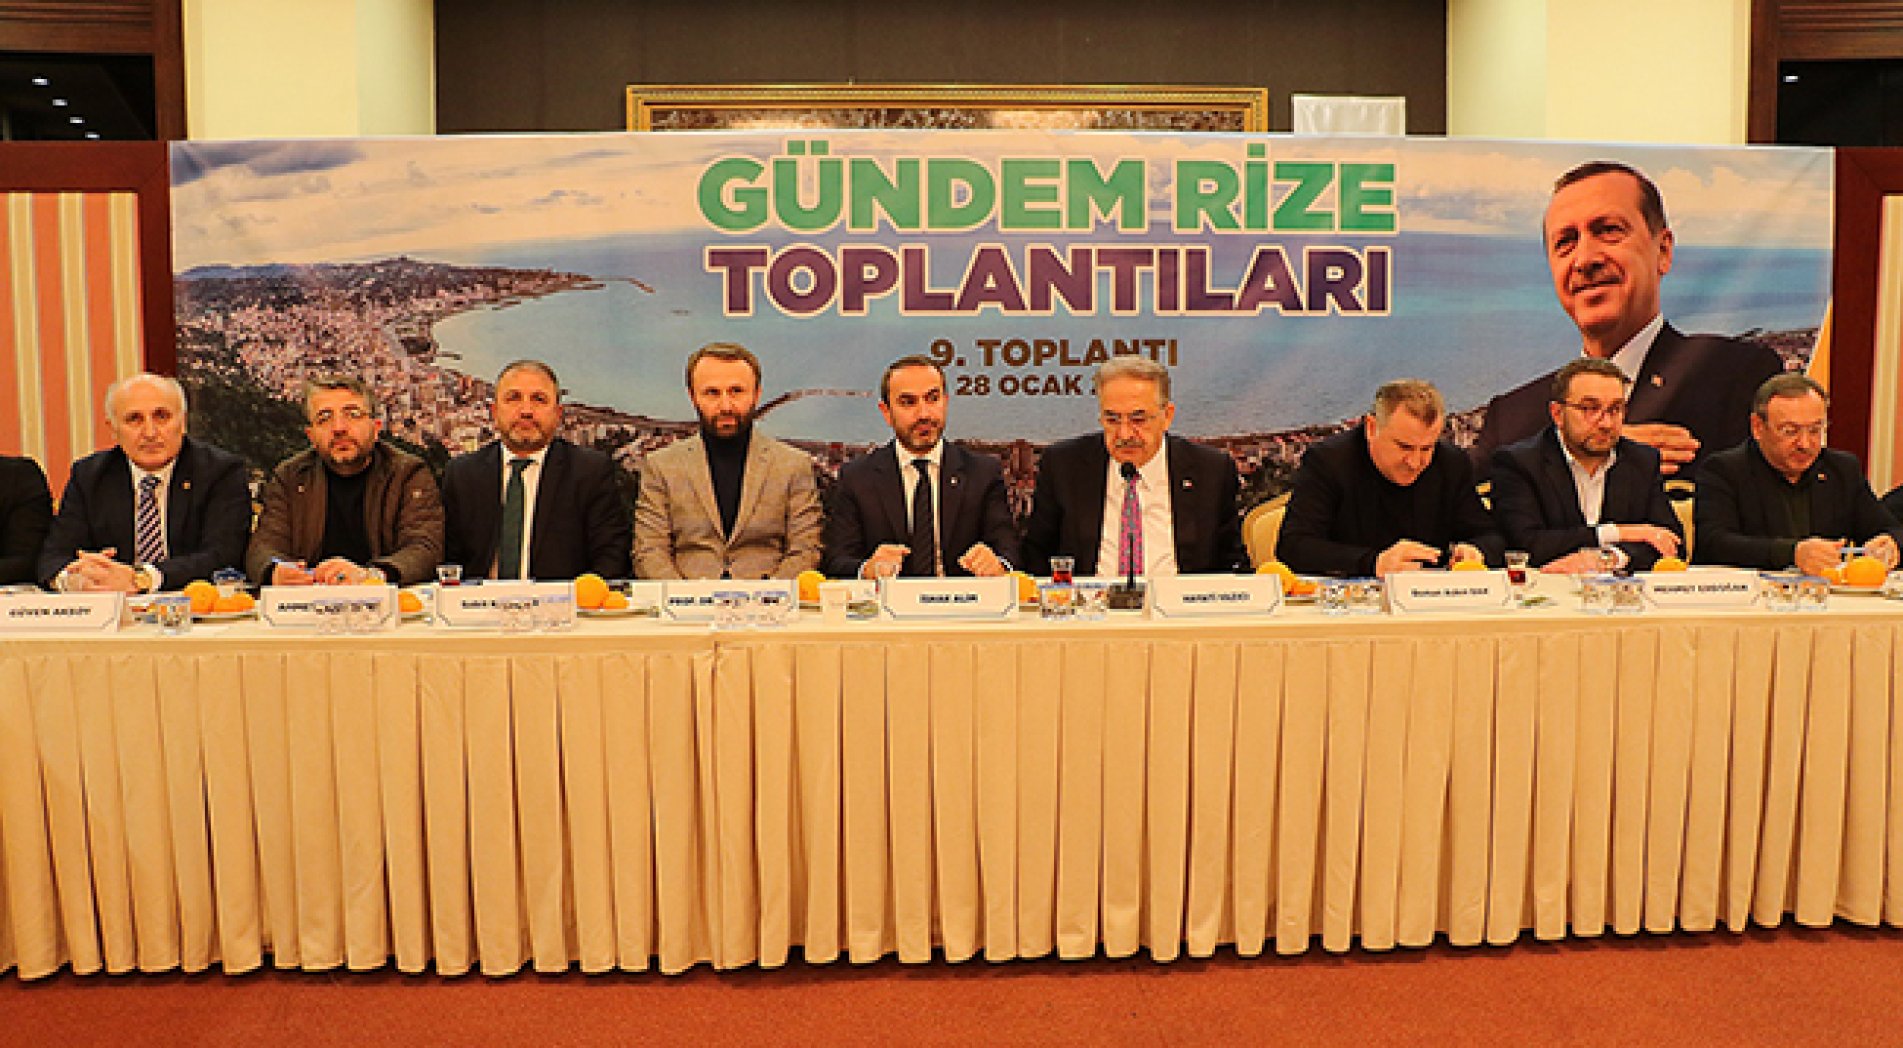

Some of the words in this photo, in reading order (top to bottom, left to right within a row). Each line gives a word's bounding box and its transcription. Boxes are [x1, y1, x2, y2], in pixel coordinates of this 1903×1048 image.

[698, 139, 1146, 231] GÜNDEM
[1175, 141, 1397, 232] RİZE
[707, 246, 1391, 314] TOPLANTILARI
[930, 339, 967, 367] 9.
[956, 374, 990, 396] 28
[998, 374, 1082, 396] OCAK
